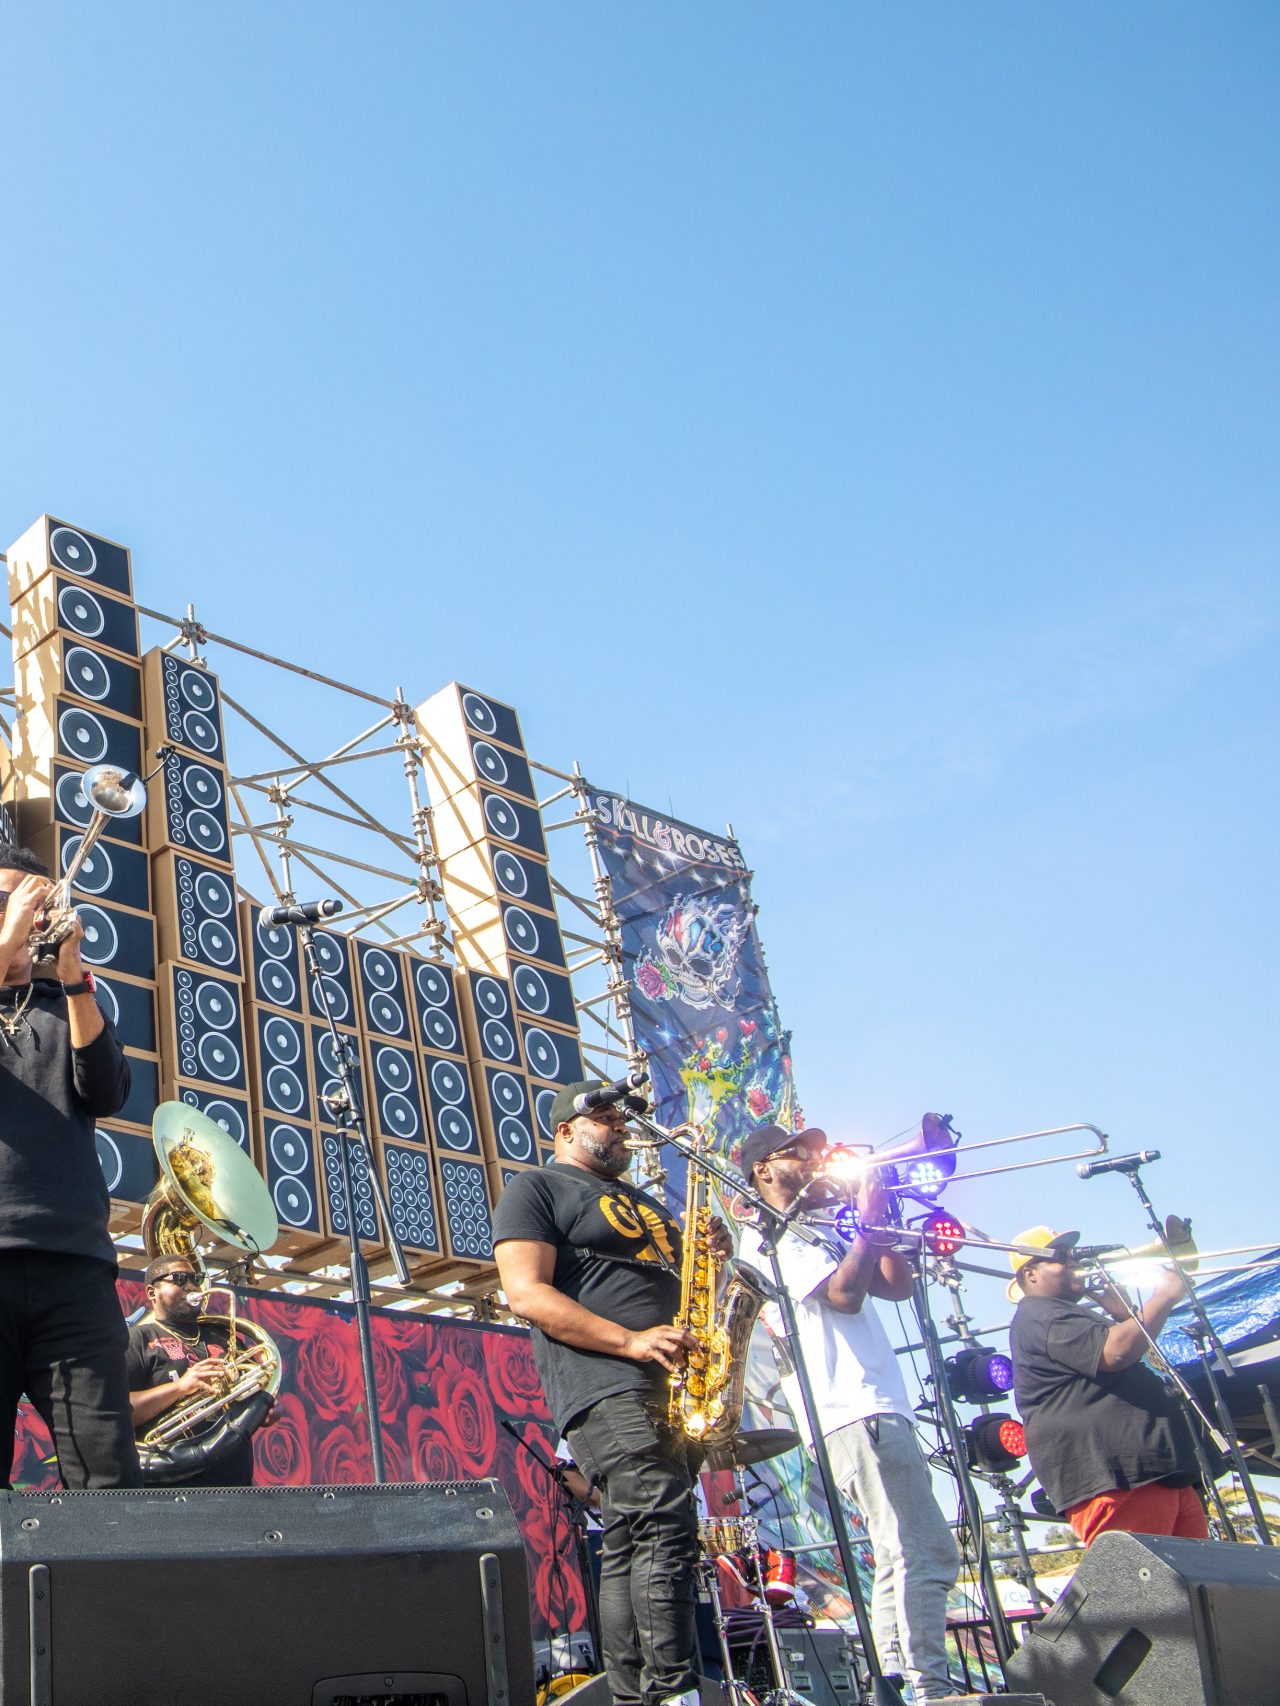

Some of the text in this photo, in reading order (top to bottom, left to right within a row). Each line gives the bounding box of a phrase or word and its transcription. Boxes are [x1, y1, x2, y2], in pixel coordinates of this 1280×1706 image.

[595, 796, 745, 868] SKULL & ROSES
